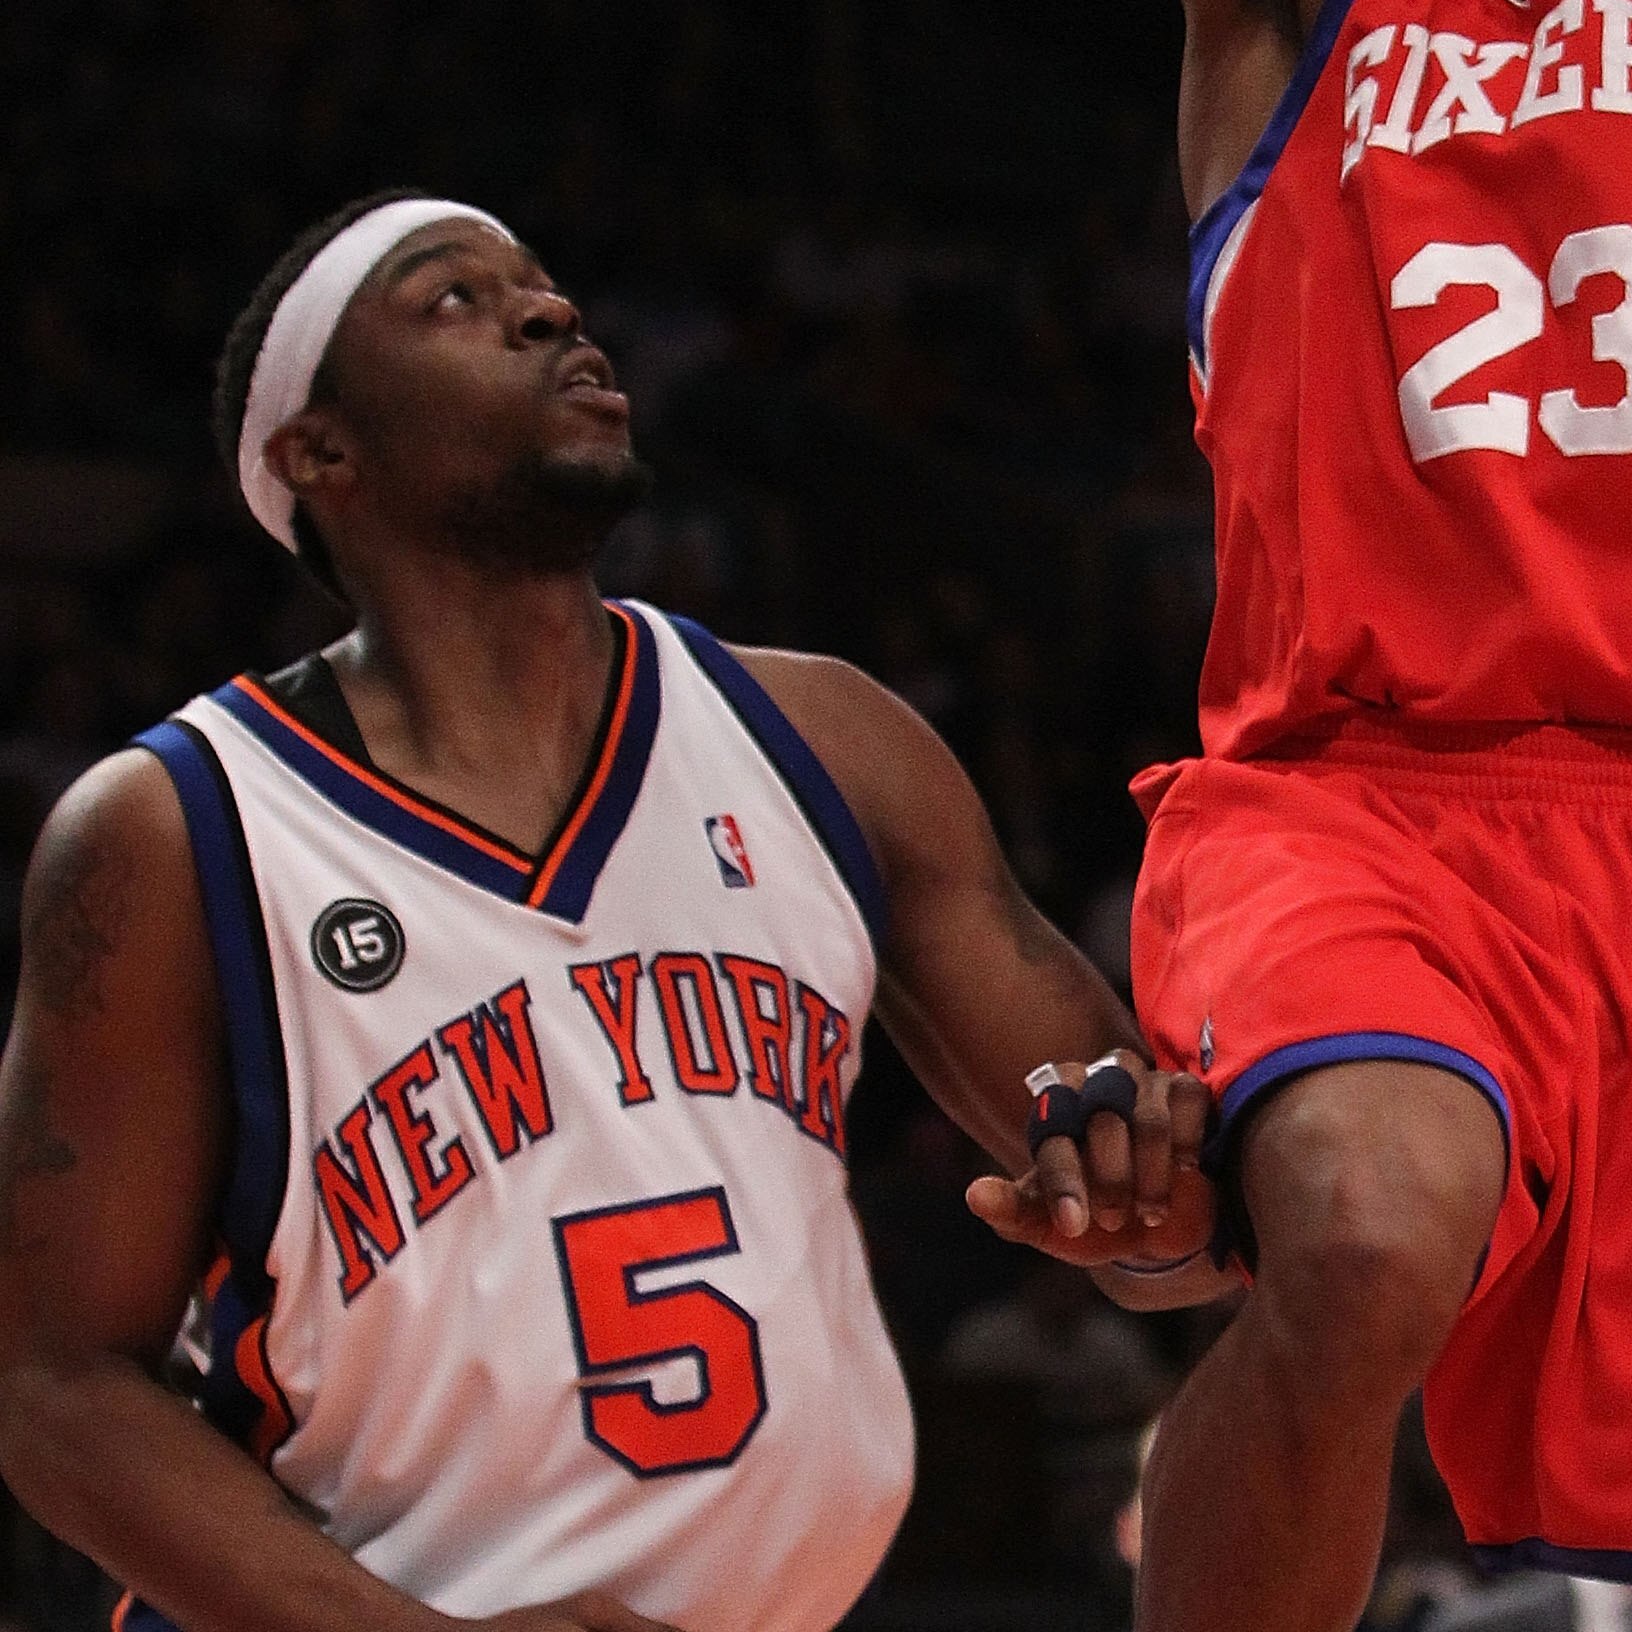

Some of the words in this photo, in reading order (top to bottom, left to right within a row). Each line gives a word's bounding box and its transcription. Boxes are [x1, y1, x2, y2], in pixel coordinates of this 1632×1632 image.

[331, 916, 386, 970] 15
[311, 976, 556, 1307] NEW
[568, 950, 851, 1159] YORK
[550, 1185, 769, 1480] 5
